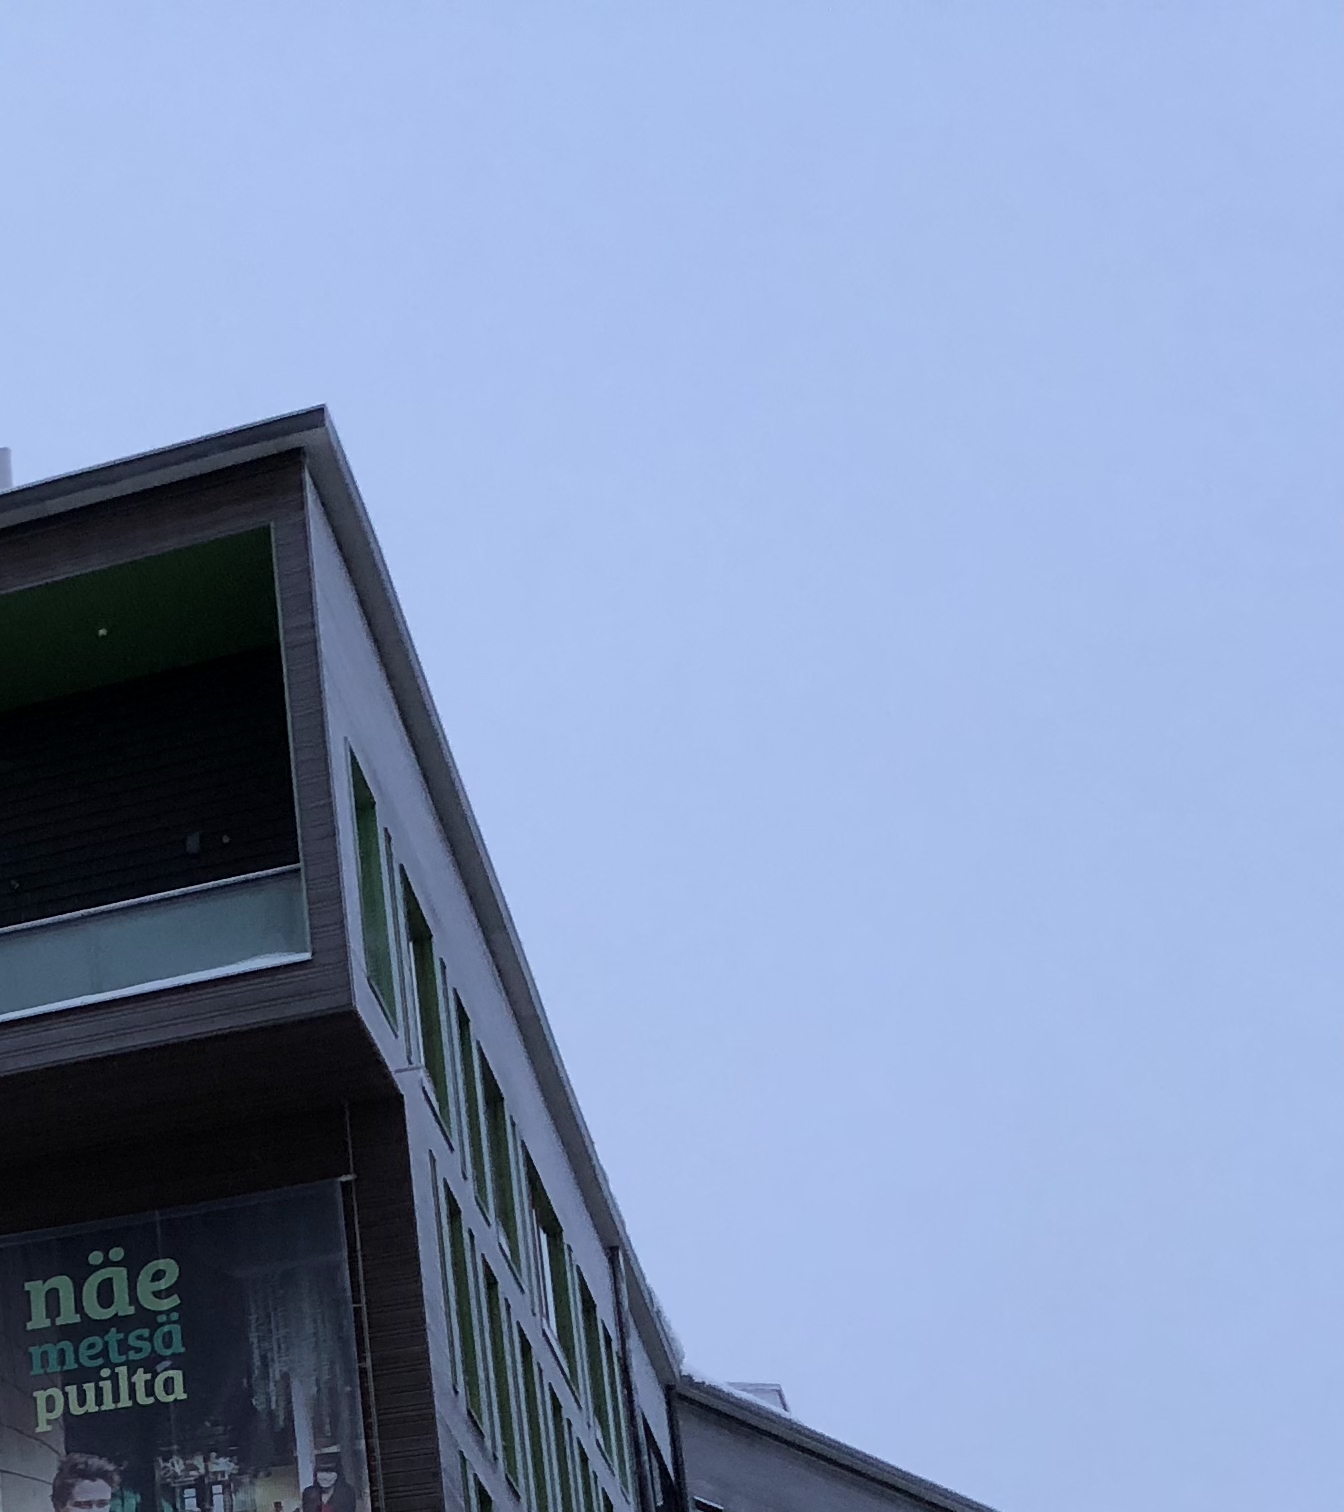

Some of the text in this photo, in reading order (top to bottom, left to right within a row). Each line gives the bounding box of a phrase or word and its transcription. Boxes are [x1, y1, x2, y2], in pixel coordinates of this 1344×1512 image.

[24, 1247, 181, 1330] näe
[28, 1312, 186, 1376] metsä
[33, 1366, 188, 1433] puilta
